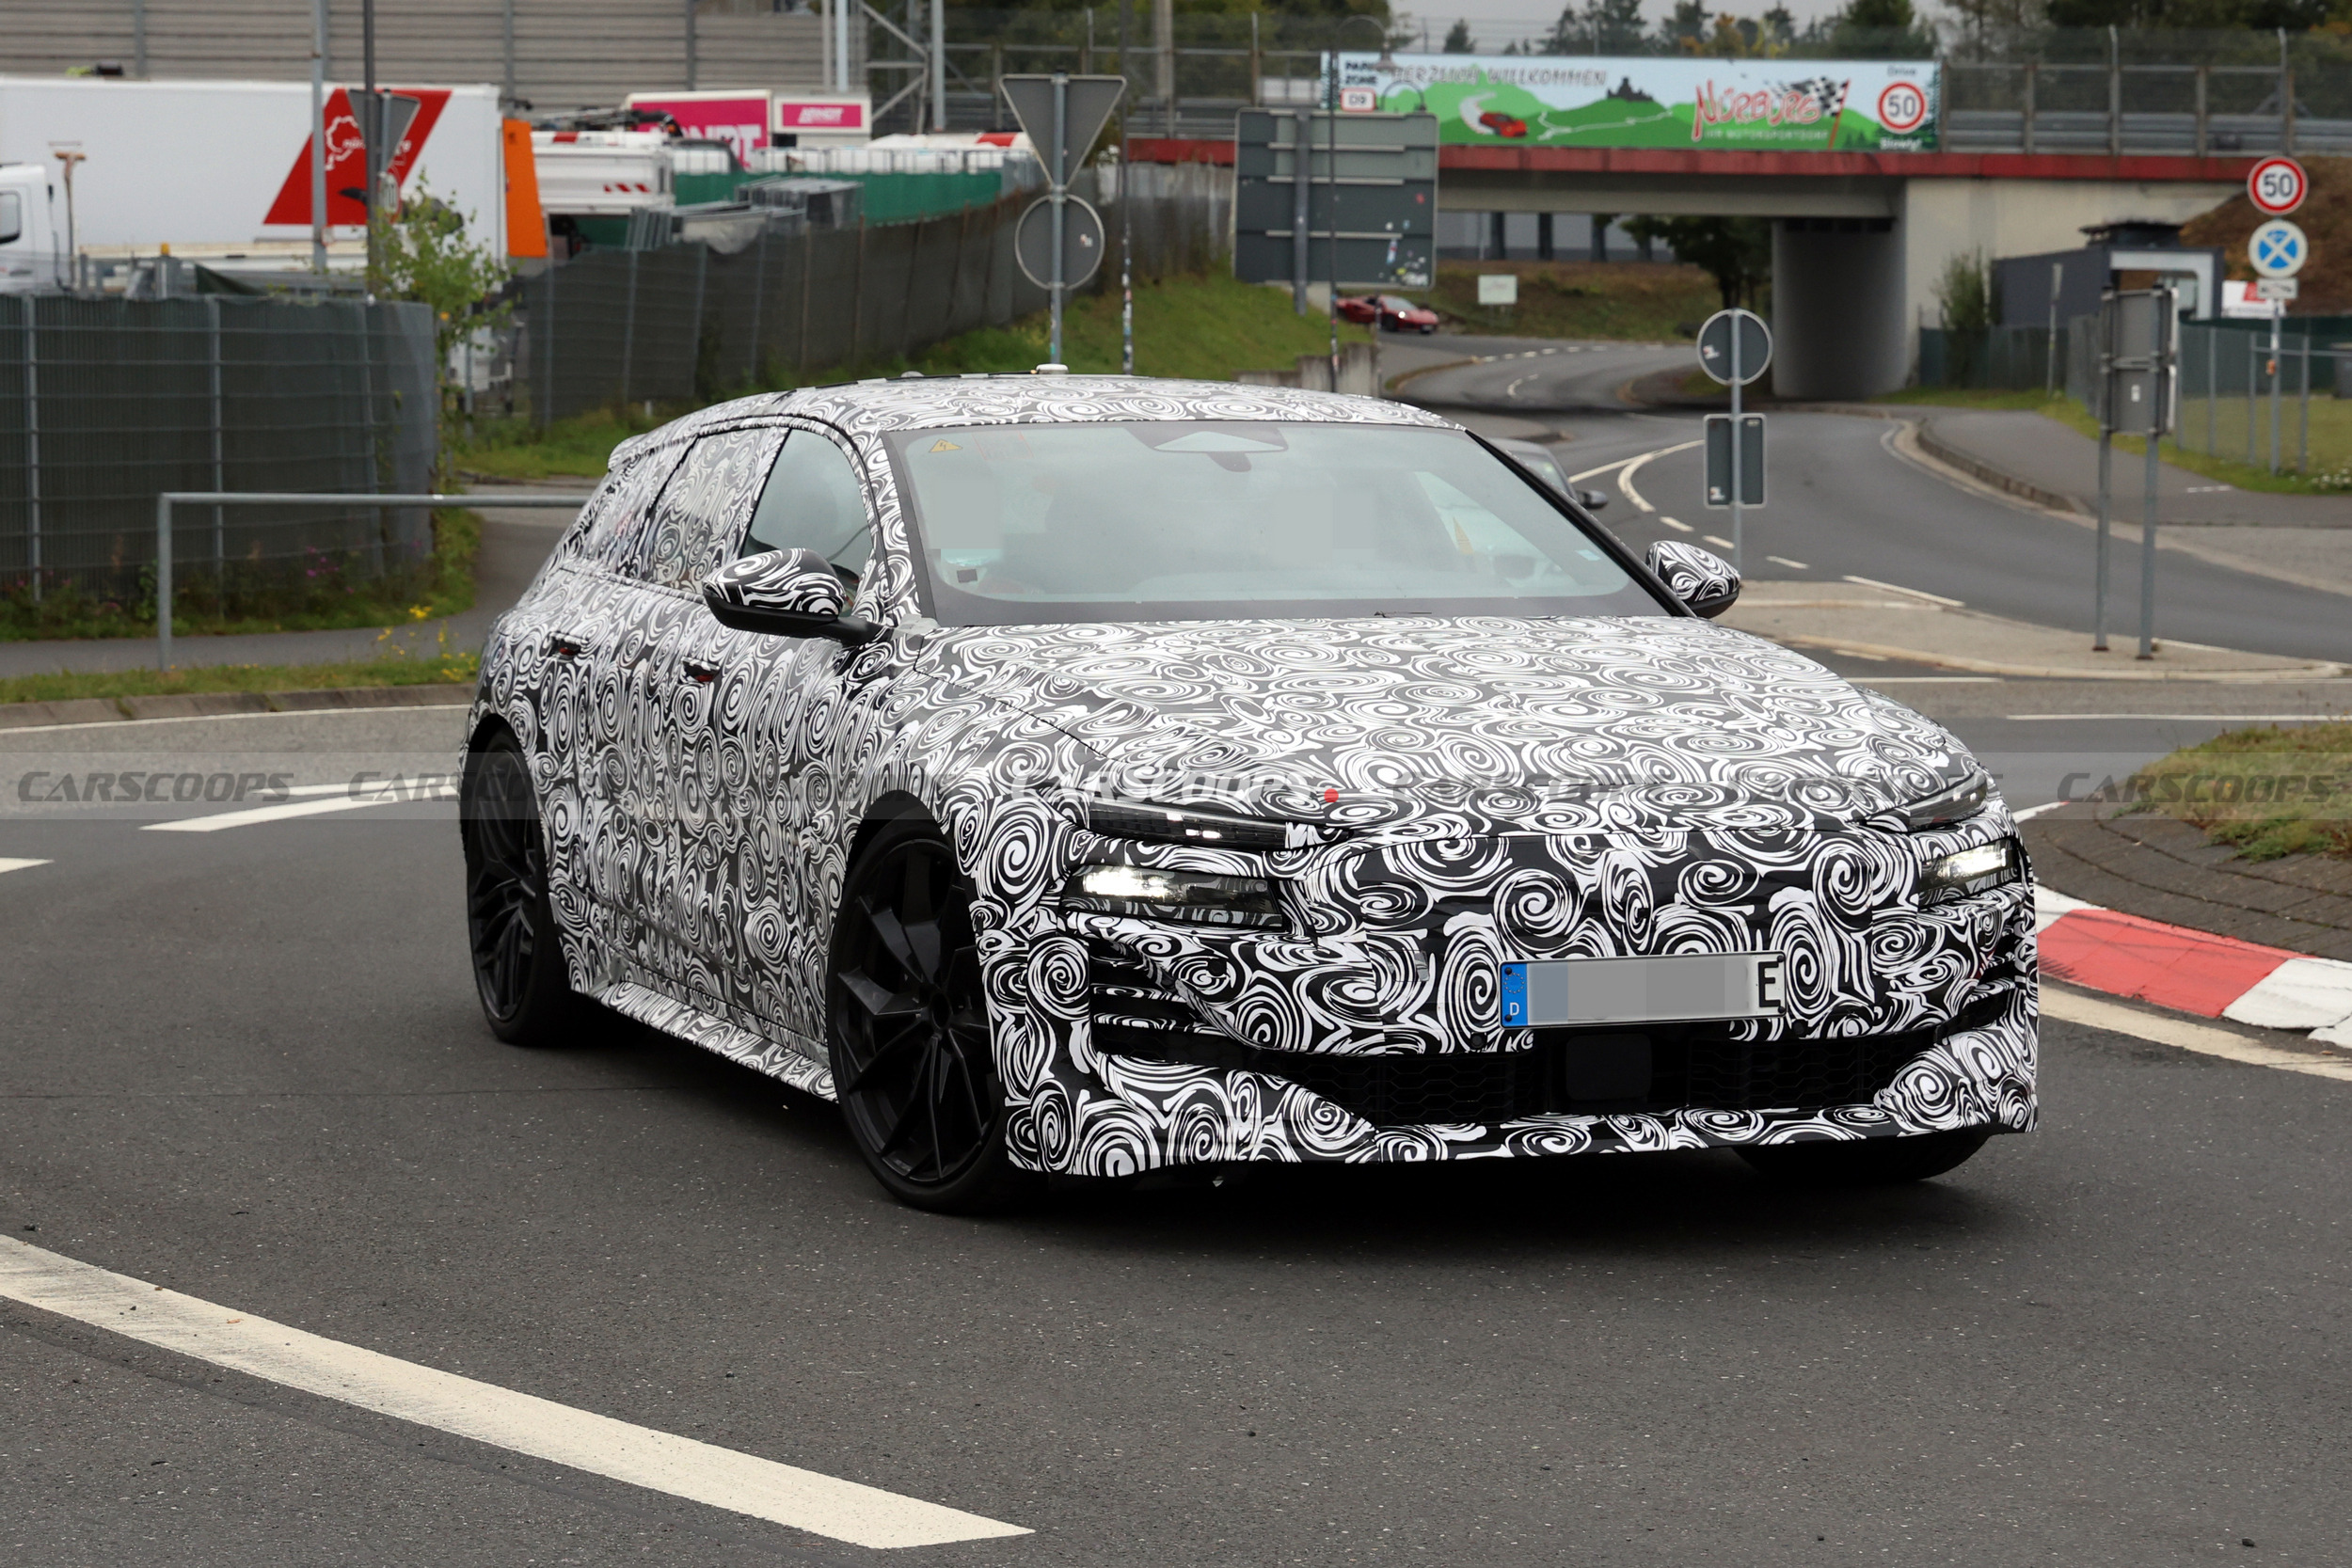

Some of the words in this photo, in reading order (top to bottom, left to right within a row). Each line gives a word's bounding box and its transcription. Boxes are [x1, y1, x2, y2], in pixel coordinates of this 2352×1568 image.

[1487, 67, 1607, 86] WILLKOMMEN
[1888, 95, 1916, 118] 50
[2263, 174, 2294, 198] 50
[1509, 1002, 1520, 1016] D
[1757, 960, 1782, 1008] E
